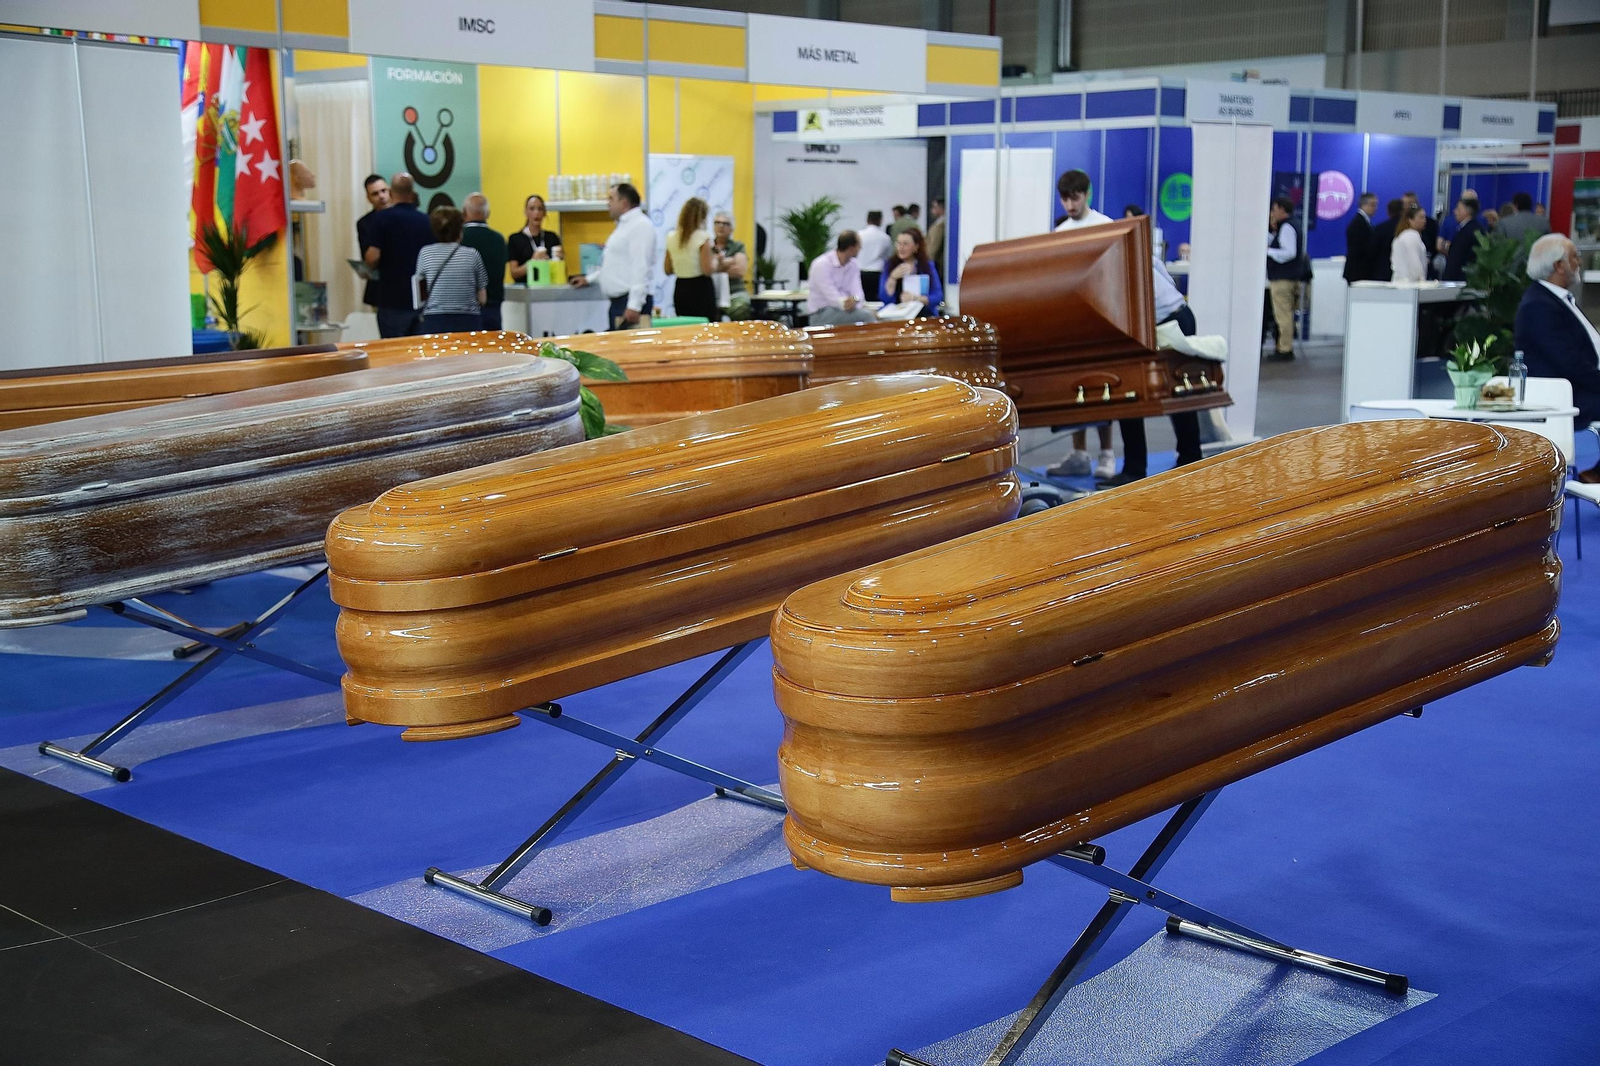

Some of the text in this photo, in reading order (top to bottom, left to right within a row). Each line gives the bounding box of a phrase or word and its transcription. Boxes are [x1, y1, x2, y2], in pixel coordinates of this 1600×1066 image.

[458, 17, 496, 34] IMSC
[797, 45, 860, 64] MÁS METAL
[386, 67, 464, 84] FORMACIÓN
